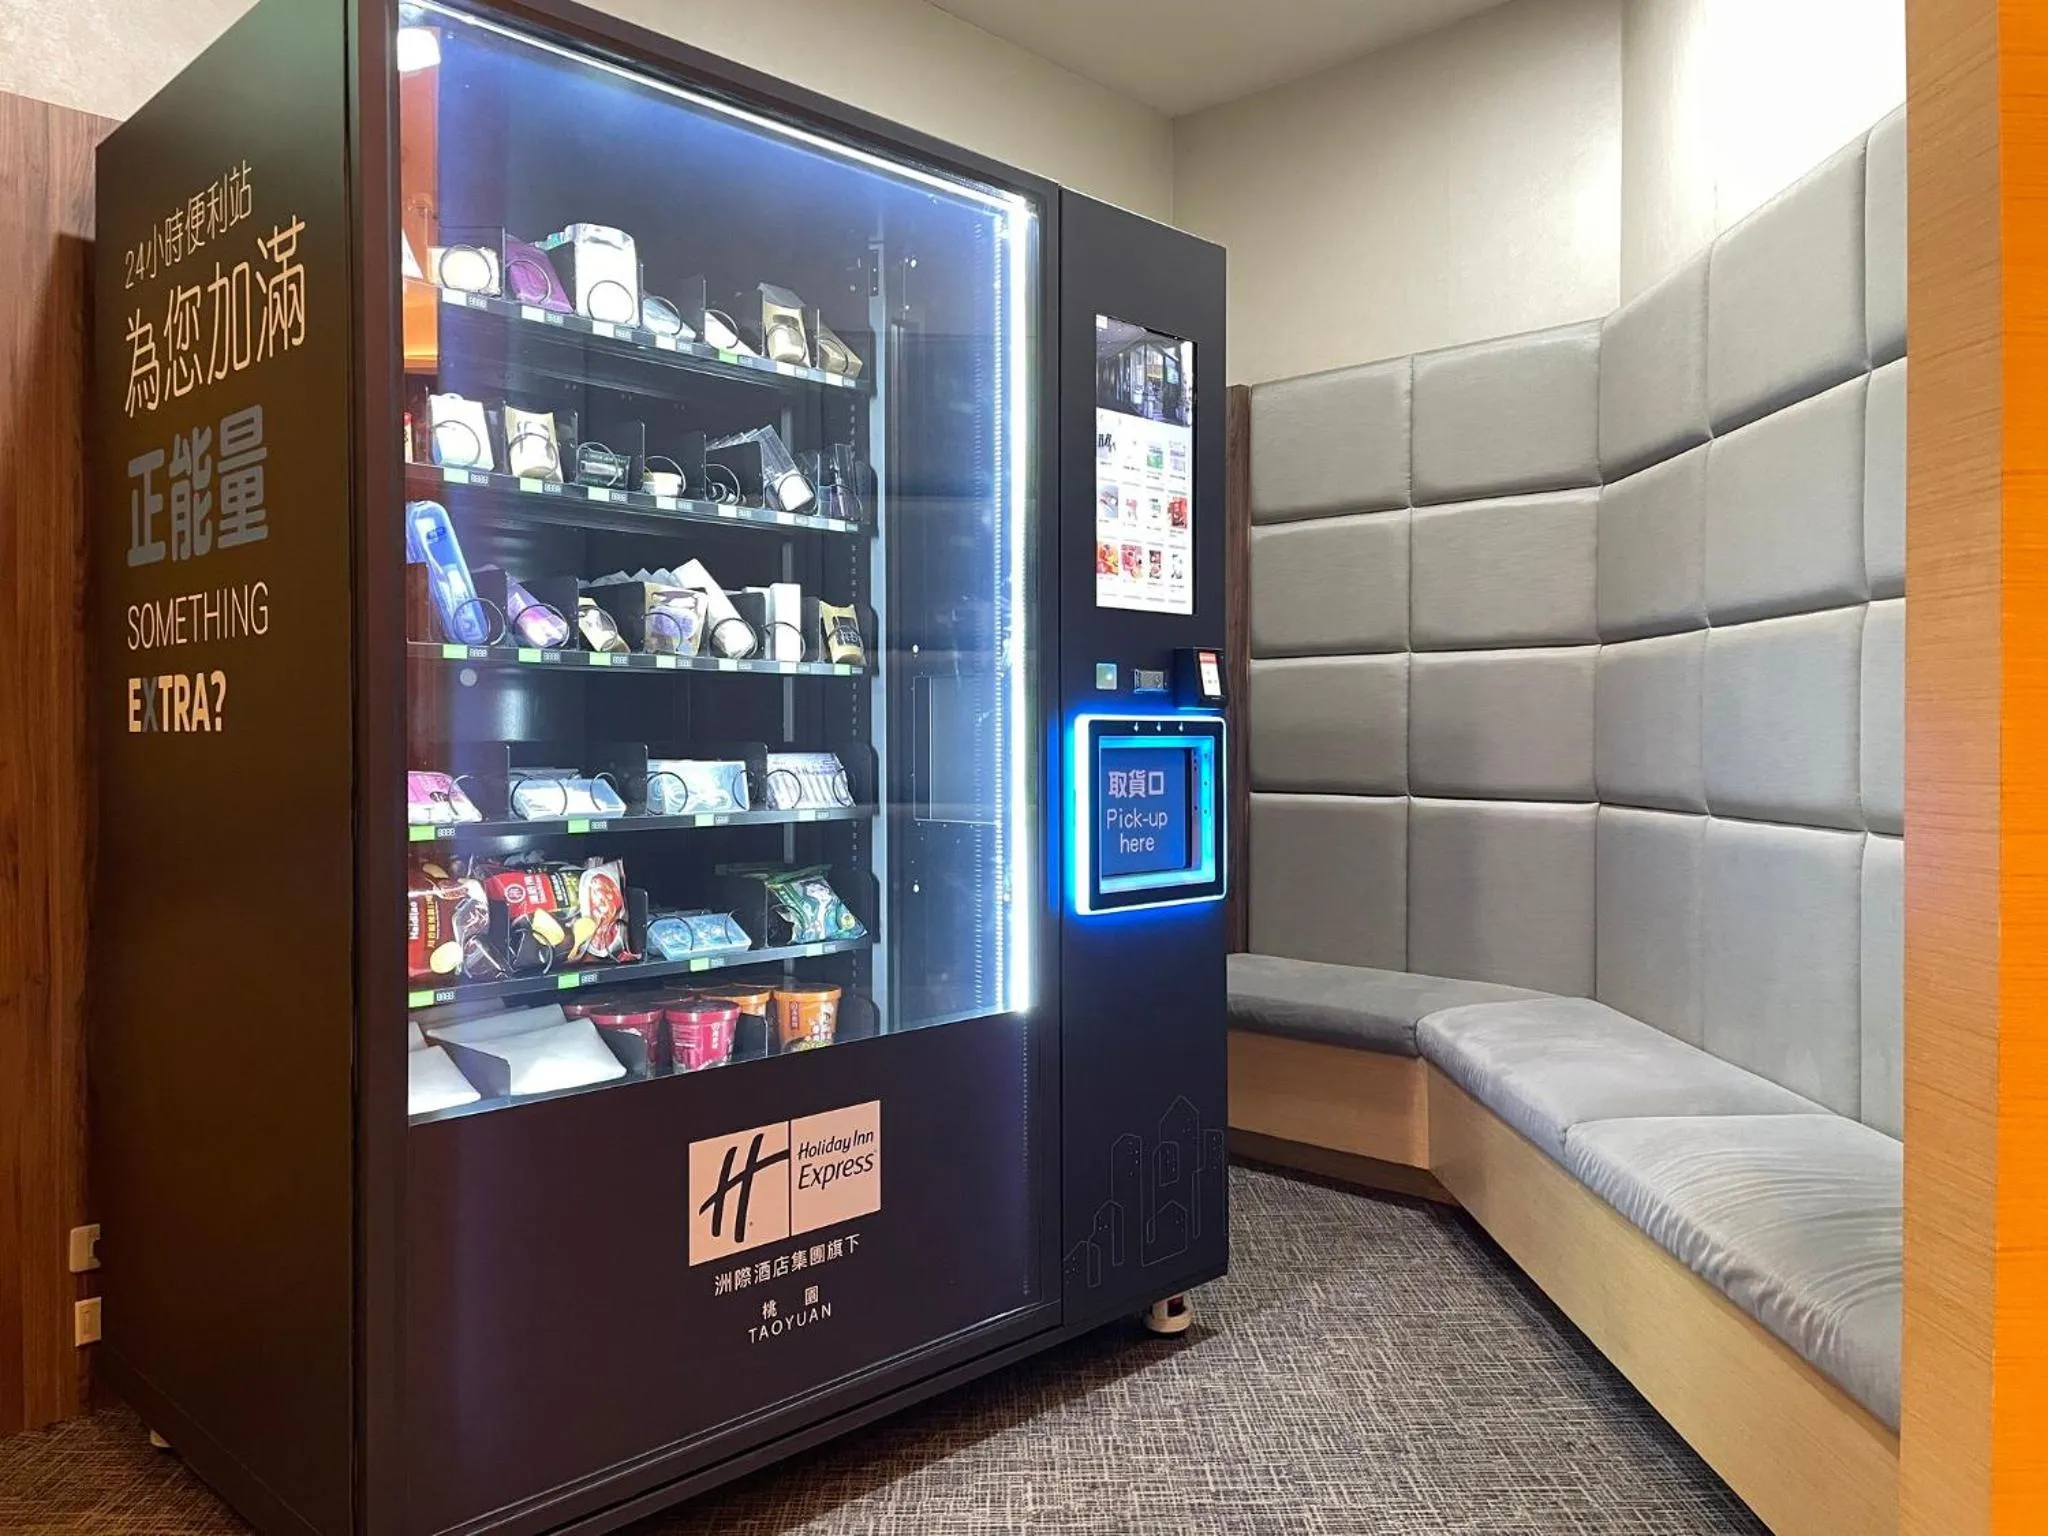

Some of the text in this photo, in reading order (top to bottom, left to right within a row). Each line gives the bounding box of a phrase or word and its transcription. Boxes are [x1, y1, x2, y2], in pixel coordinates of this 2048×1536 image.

[124, 159, 253, 290] 24小時便利站
[124, 213, 306, 419] 為您加滿
[127, 404, 270, 568] 正能量
[127, 581, 270, 651] SOMETHING
[128, 669, 228, 733] EXTRA?
[1108, 770, 1164, 798] 取貨口
[1106, 807, 1168, 830] Pick-up
[1119, 833, 1155, 853] here
[797, 1129, 875, 1160] Holiday Inn
[798, 1153, 874, 1190] Express
[714, 1233, 861, 1297] 洲際酒店集團旗下
[747, 1303, 832, 1344] TAOYUAN
